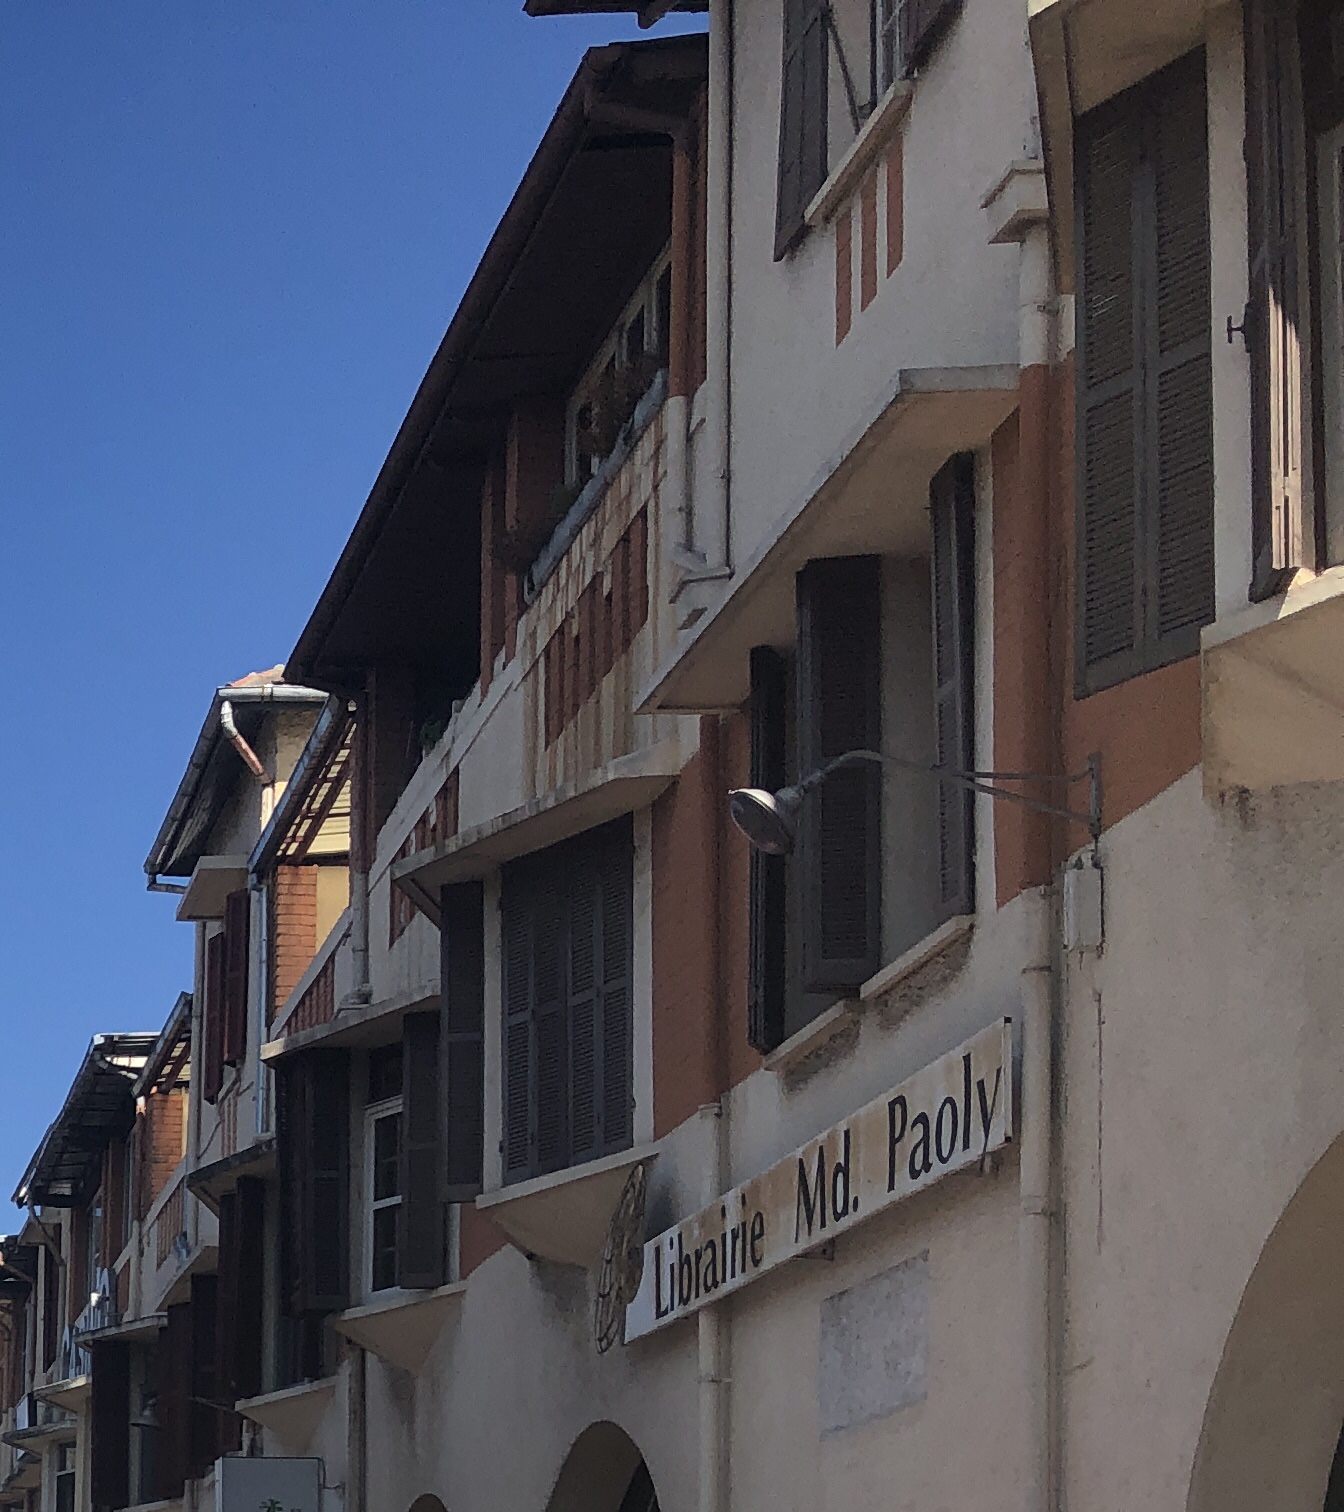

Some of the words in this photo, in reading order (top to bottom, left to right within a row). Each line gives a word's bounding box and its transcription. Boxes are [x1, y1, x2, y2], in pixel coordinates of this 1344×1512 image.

[654, 1192, 765, 1320] Librairie
[795, 1129, 859, 1244] Md.
[886, 1052, 1003, 1194] Paoly
